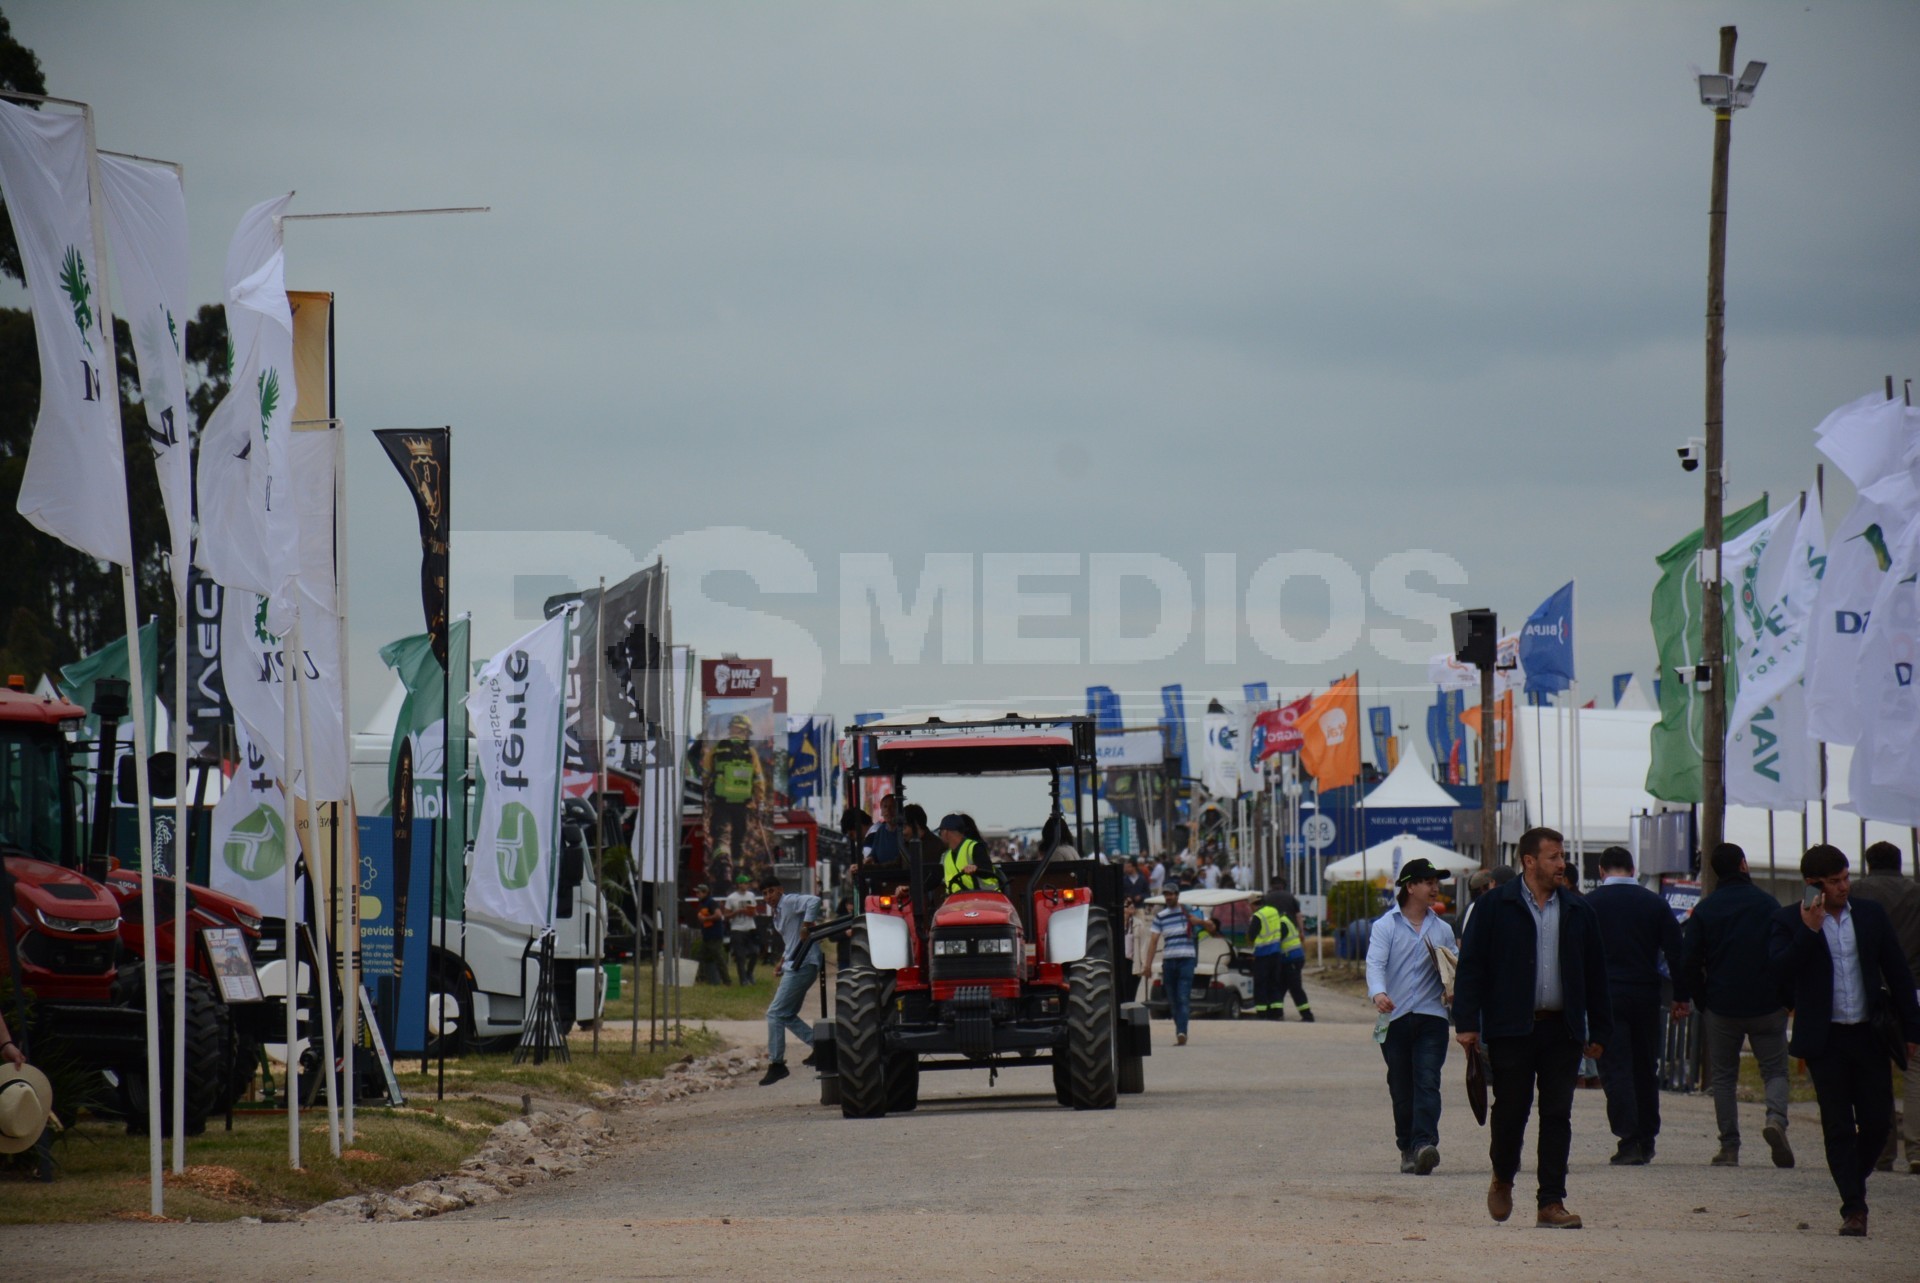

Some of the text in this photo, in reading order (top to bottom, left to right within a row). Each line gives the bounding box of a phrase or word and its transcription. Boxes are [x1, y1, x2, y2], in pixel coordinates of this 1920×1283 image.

[731, 668, 761, 678] WILD
[731, 678, 757, 689] LINE
[1096, 747, 1125, 757] ARIA
